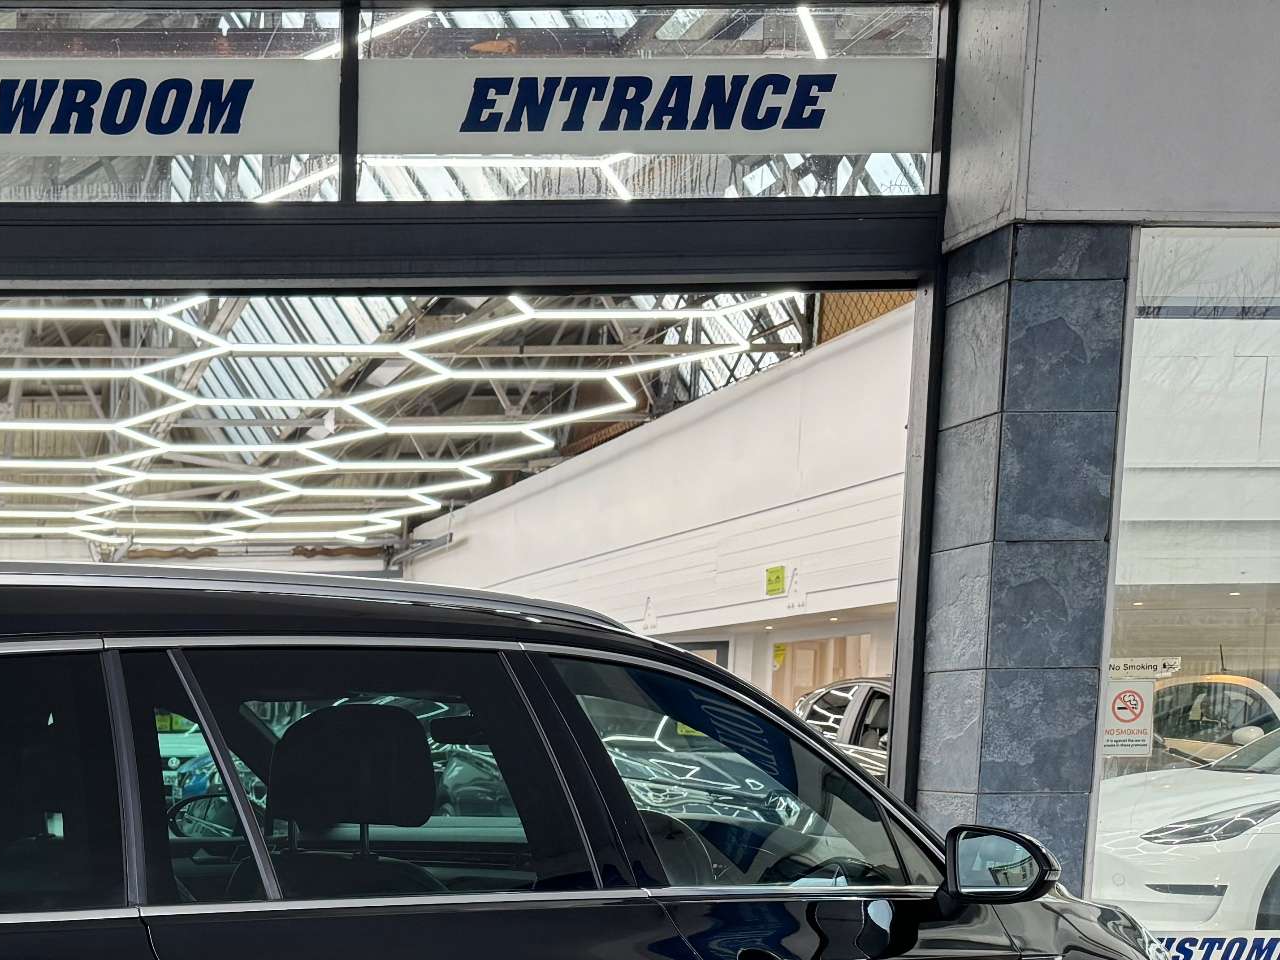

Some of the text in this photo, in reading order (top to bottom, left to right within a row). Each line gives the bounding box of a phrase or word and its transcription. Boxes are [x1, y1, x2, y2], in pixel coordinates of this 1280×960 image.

[459, 73, 838, 133] ENTRANCE
[1108, 663, 1158, 672] No Smoking
